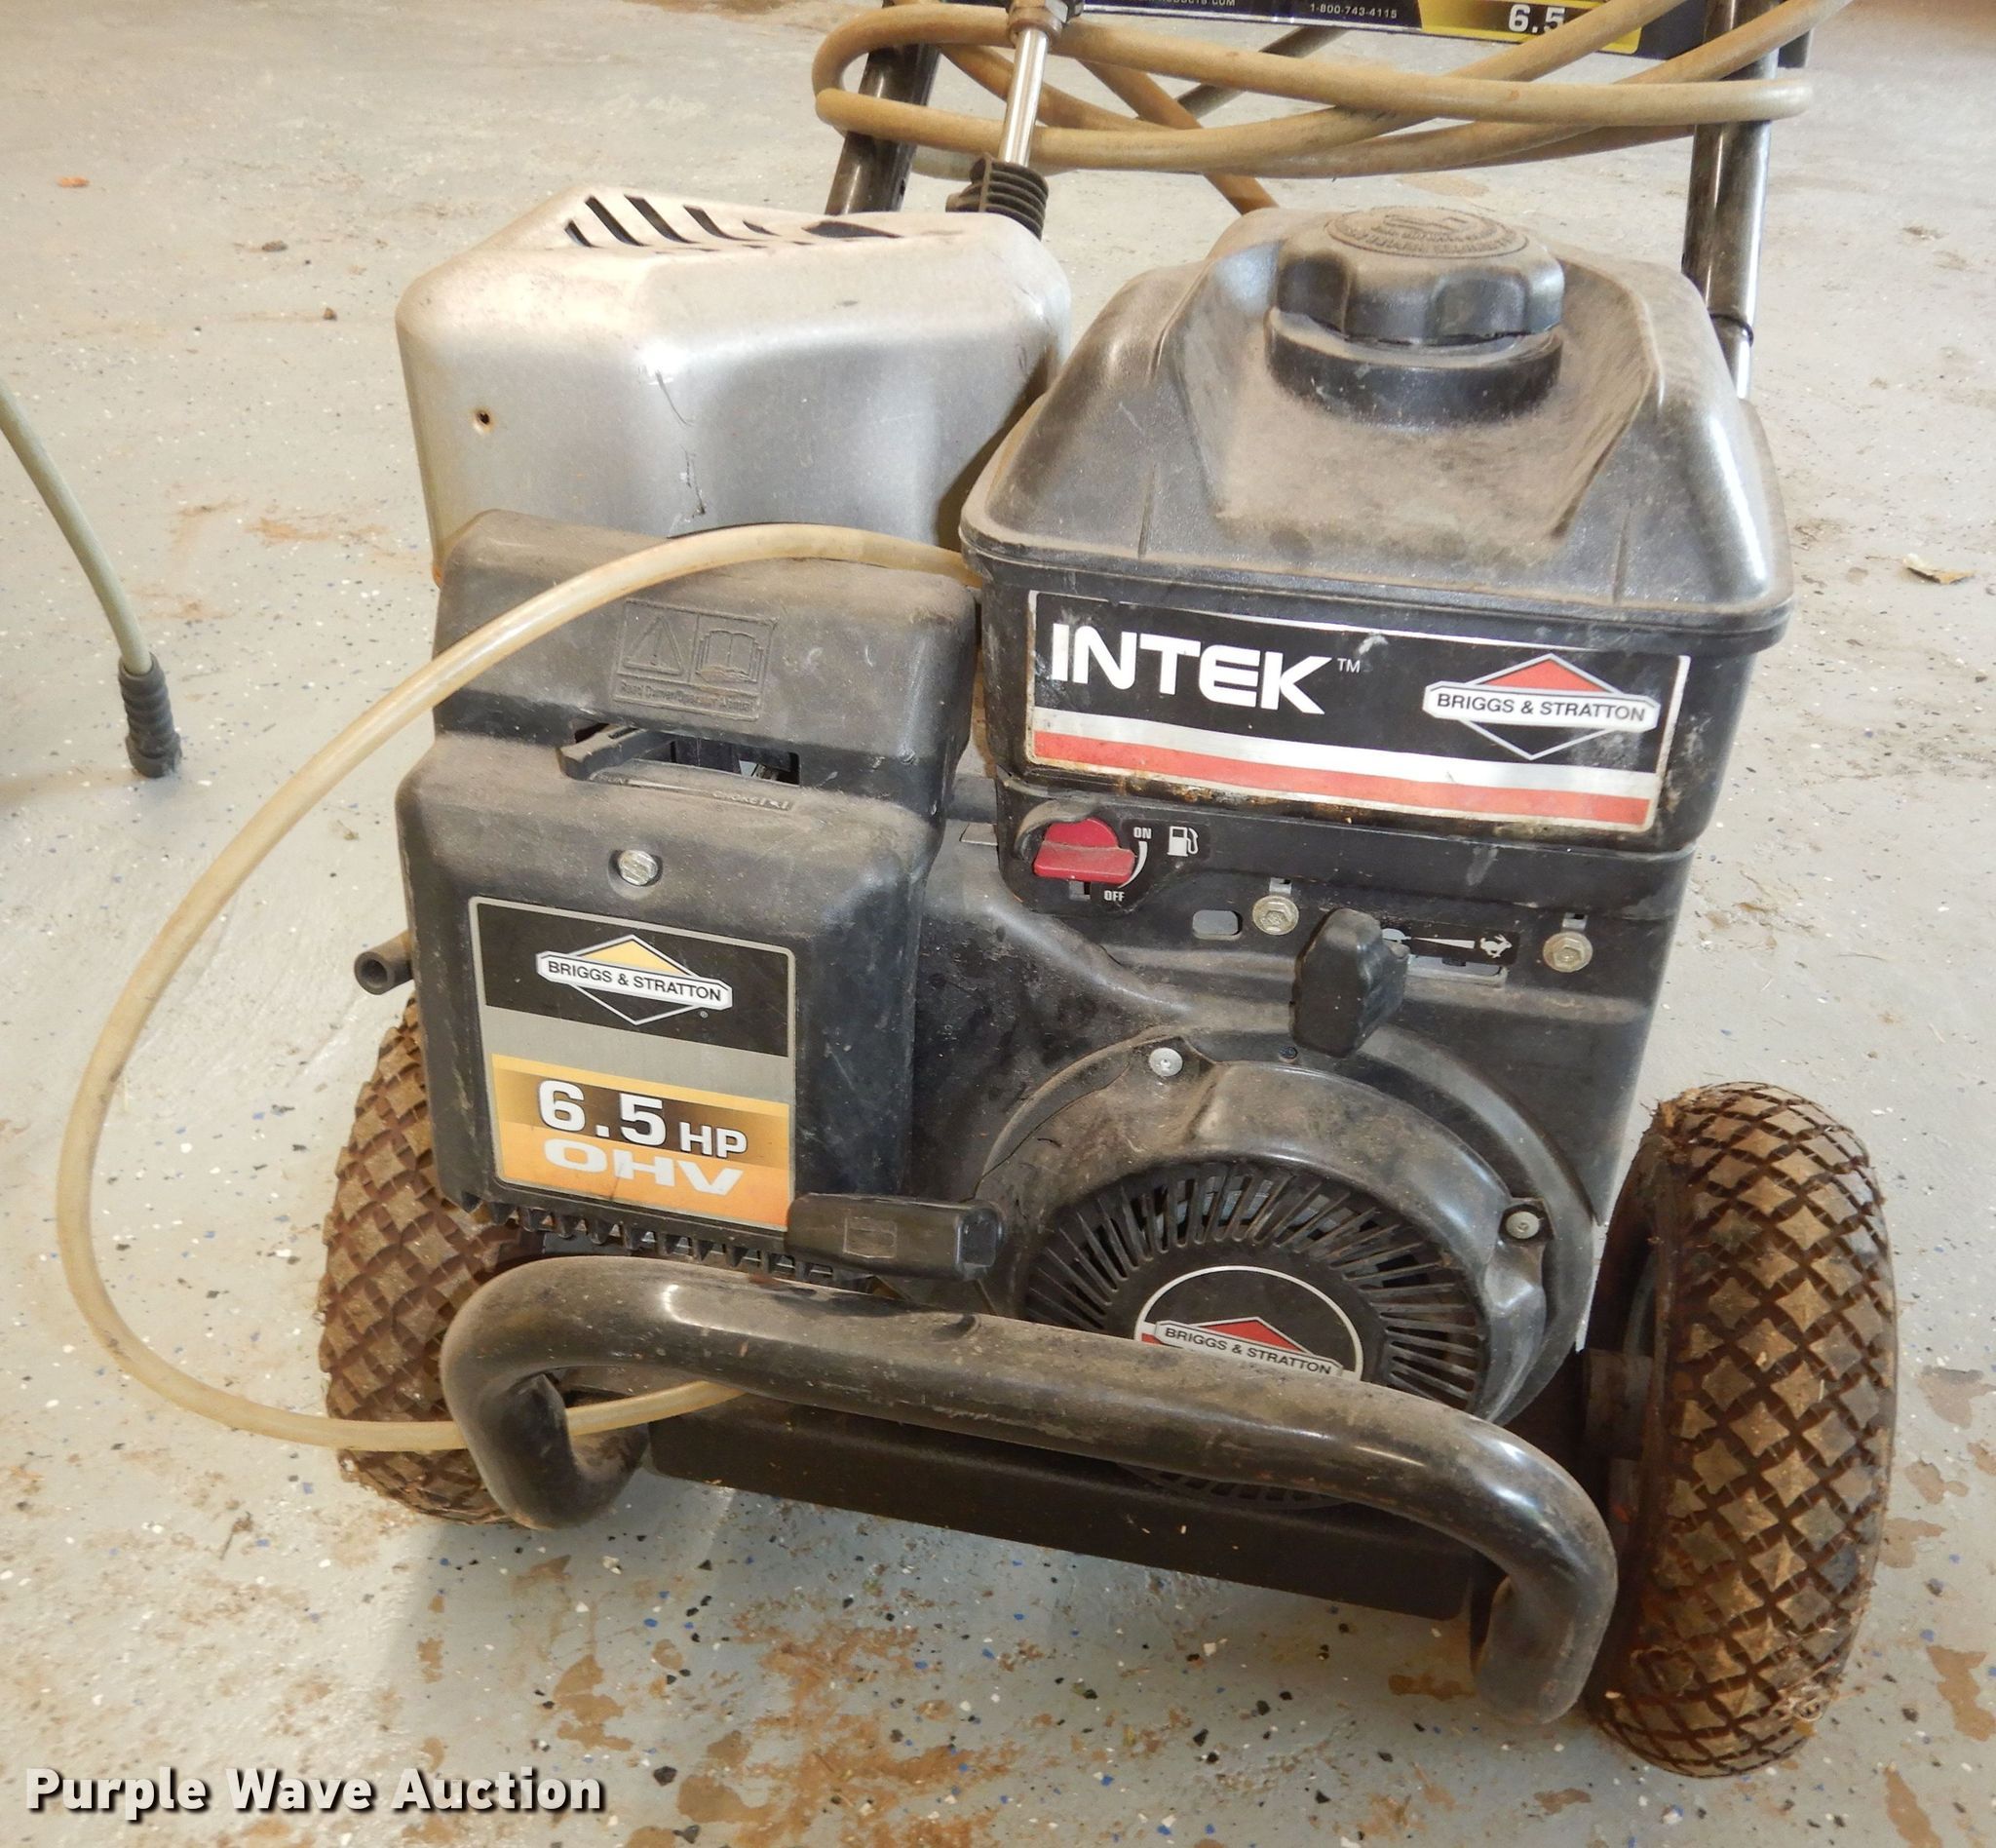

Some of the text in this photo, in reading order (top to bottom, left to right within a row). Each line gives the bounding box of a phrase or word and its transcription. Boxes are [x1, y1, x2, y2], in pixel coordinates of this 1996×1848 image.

[1051, 622, 1332, 715] INTEK
[1437, 693, 1646, 722] BRIGGS & STRATTON
[1133, 827, 1152, 839] ON
[1103, 890, 1125, 903] OFF
[548, 960, 722, 1002] BRIGGS & STRATTON
[538, 1079, 748, 1159] 6.5 HP
[543, 1137, 745, 1197] OHV
[1165, 1328, 1332, 1375] BRIGGS & STRATTON
